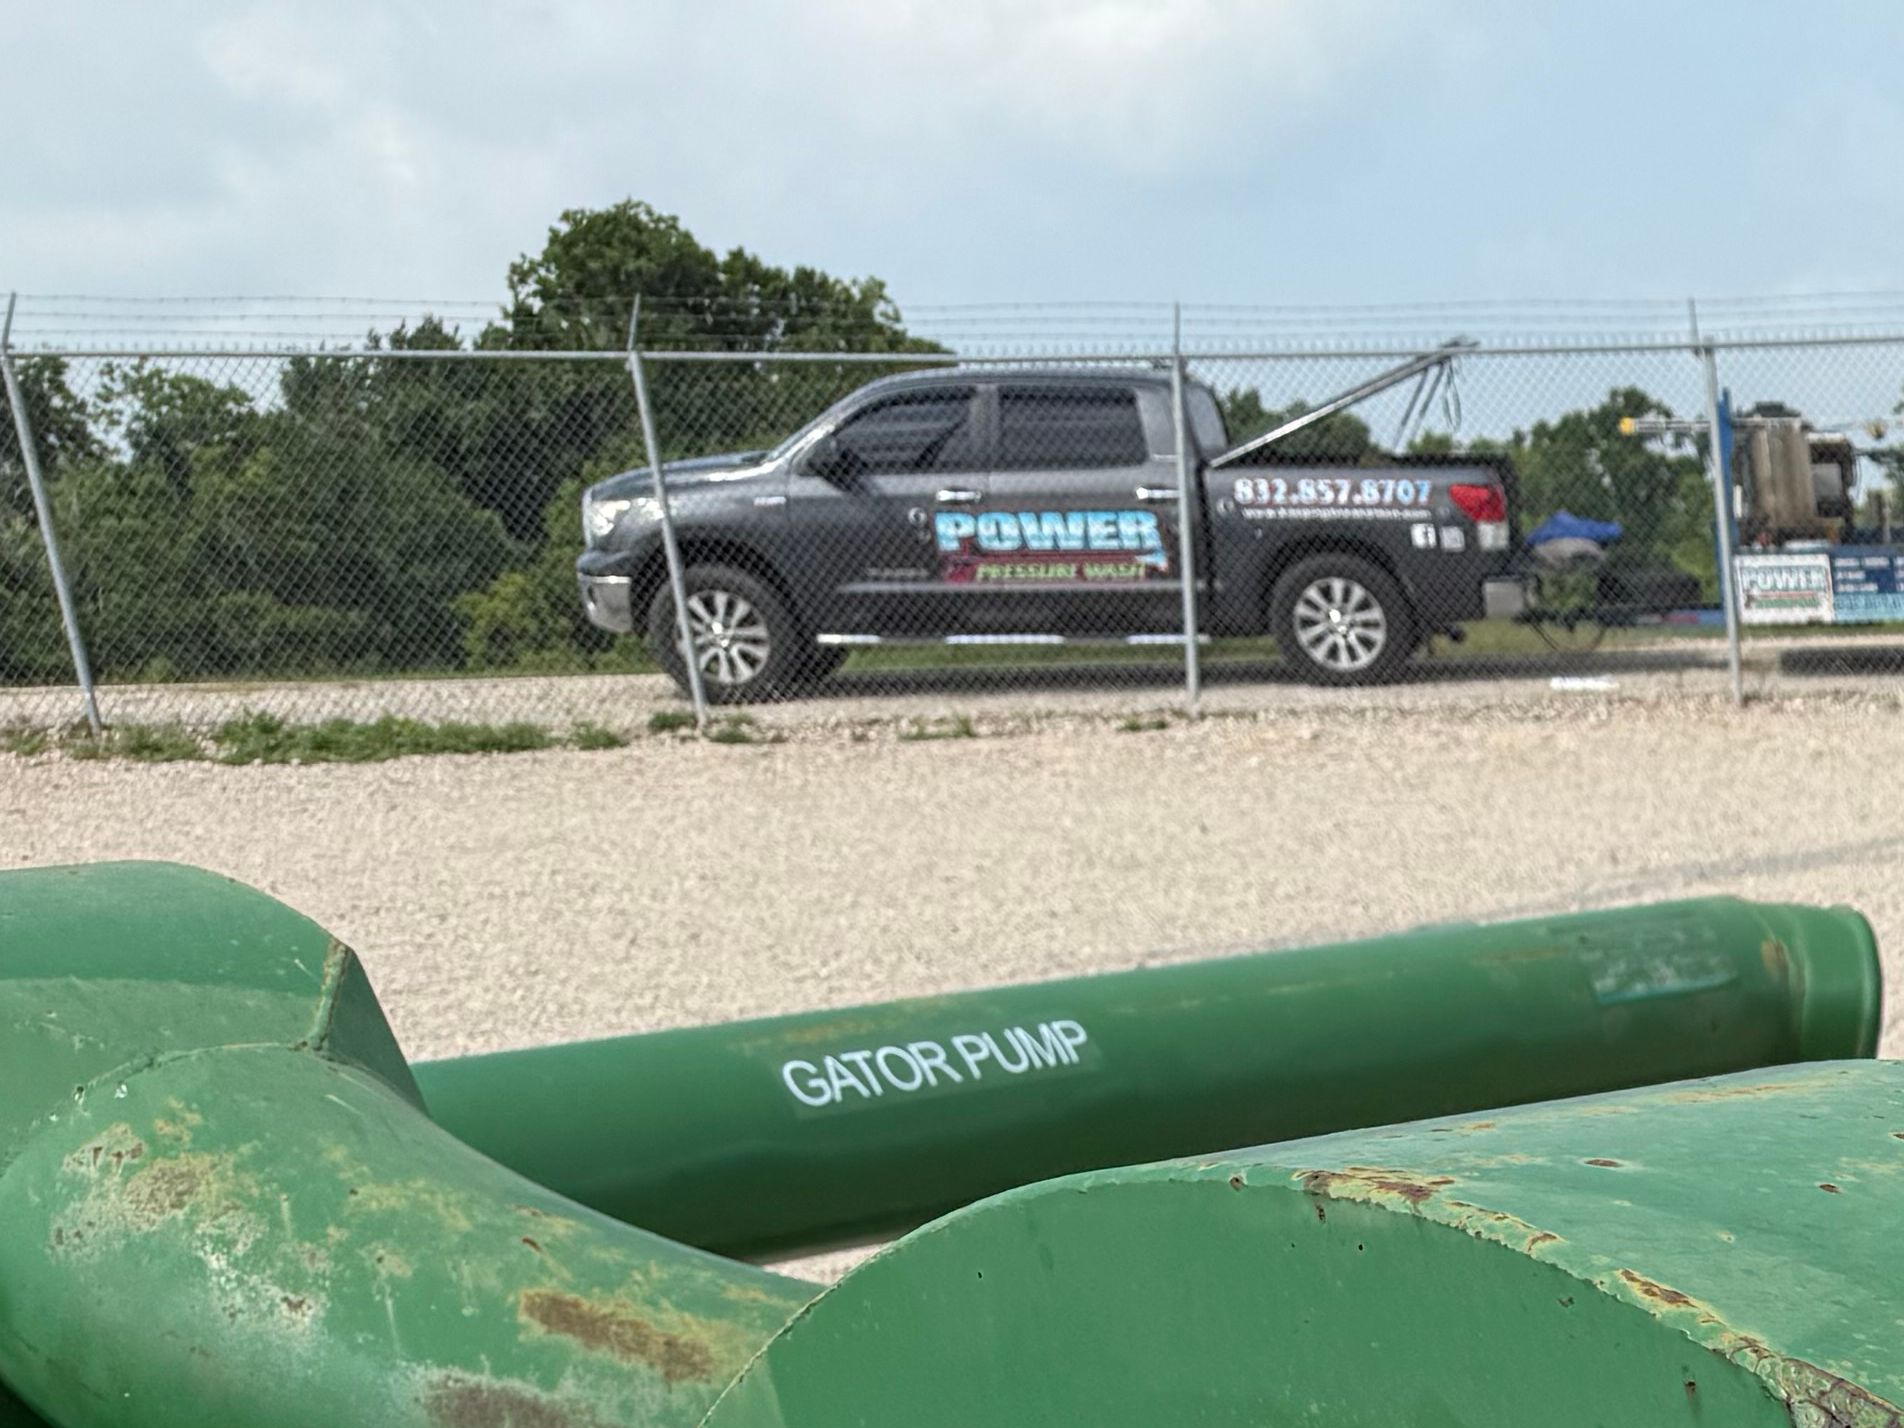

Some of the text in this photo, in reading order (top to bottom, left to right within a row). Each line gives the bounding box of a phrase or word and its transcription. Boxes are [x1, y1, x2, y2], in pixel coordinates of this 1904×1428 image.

[1234, 477, 1433, 505] 832.857.8707
[934, 510, 1161, 551] POWER
[782, 1019, 1088, 1107] GATOR PUMP
